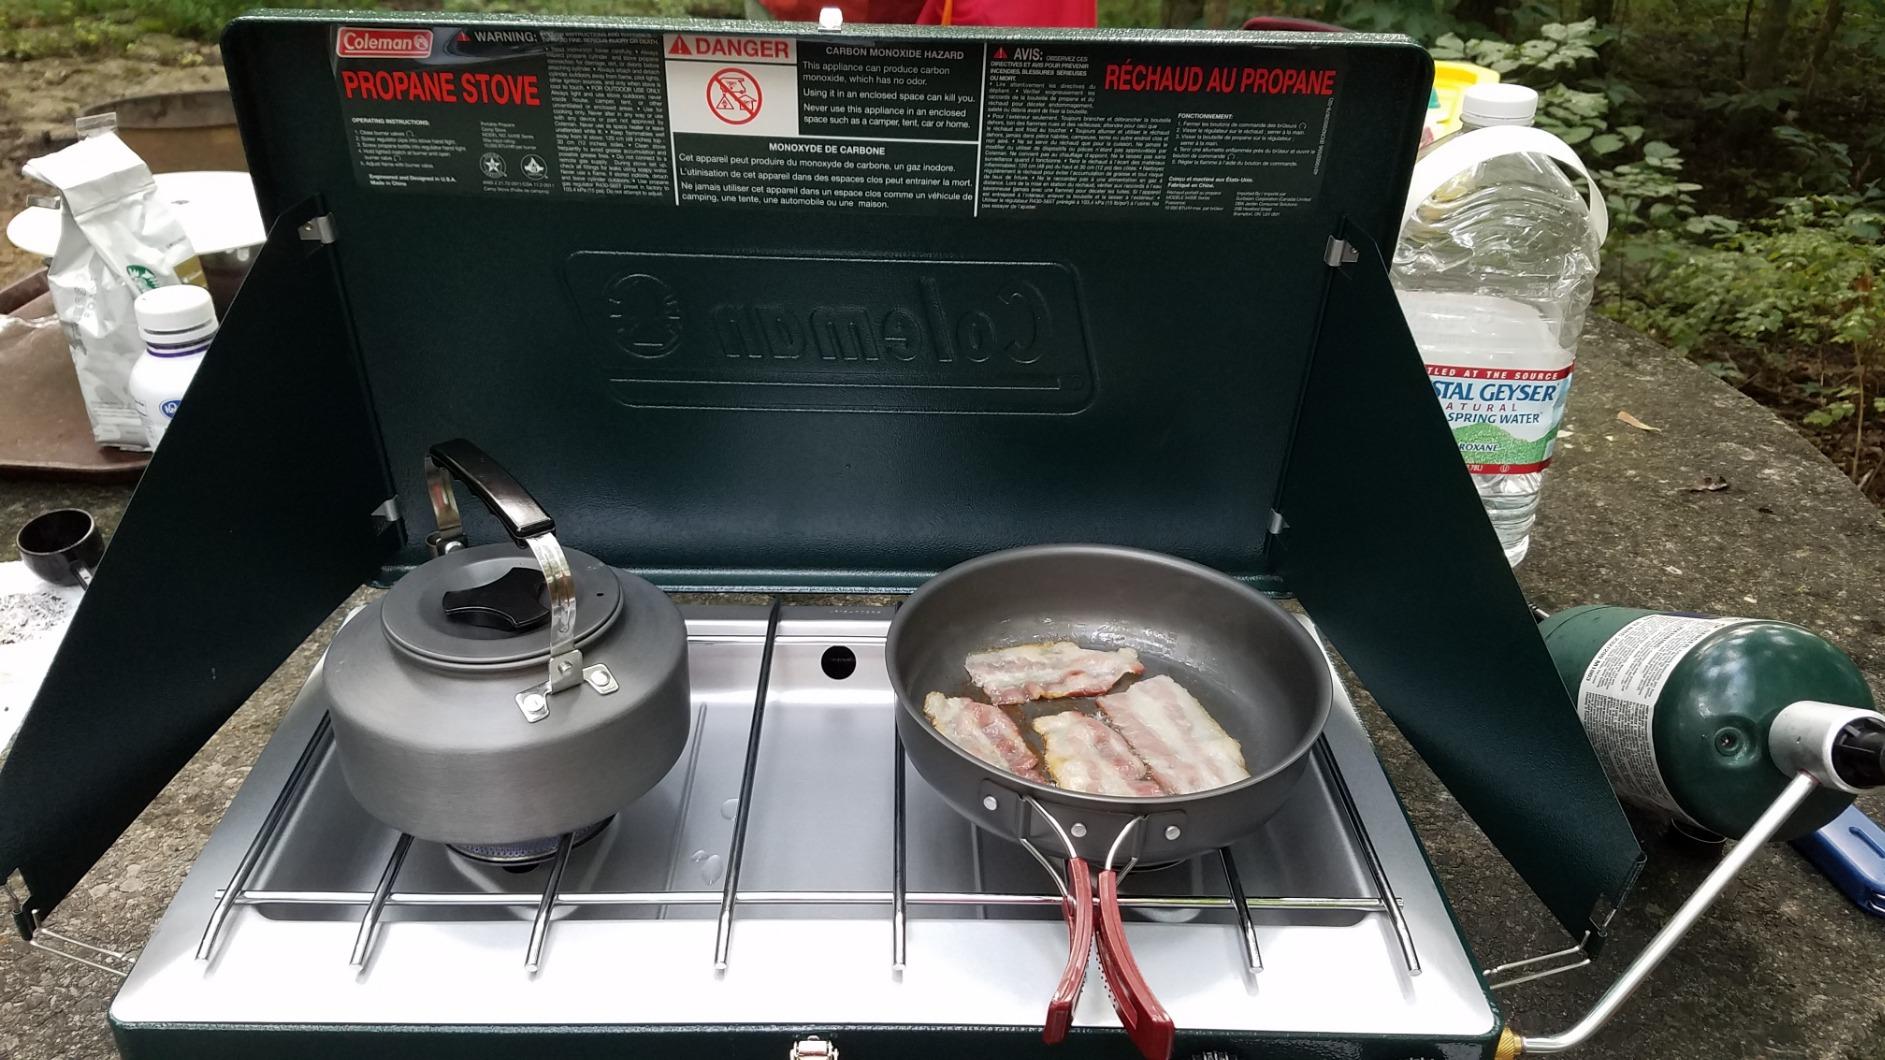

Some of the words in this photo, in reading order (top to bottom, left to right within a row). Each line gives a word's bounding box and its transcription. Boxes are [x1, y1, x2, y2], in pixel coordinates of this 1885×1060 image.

[344, 32, 412, 50] Coleman
[474, 32, 538, 42] WARNING:
[696, 38, 789, 58] DANGER
[826, 47, 867, 56] CARBON
[870, 49, 922, 58] MONOXIDE
[924, 51, 964, 59] HAZARD
[1014, 48, 1043, 61] AVIS:
[802, 61, 821, 70] This
[822, 62, 864, 73] appliance
[883, 65, 919, 74] produce
[803, 74, 847, 82] monoxide,
[849, 75, 874, 83] which
[876, 76, 892, 84] has
[906, 77, 928, 85] odor.
[1104, 58, 1202, 92] RÉCHAUD
[1207, 67, 1237, 93] AU
[1240, 68, 1336, 95] PROPANE
[342, 71, 457, 103] PROPANE
[462, 74, 540, 106] STOVE
[803, 88, 828, 99] Using
[837, 90, 845, 98] in
[804, 104, 828, 112] Never
[847, 105, 863, 113] this
[864, 107, 905, 115] appliance
[869, 119, 900, 127] camper,
[769, 143, 823, 152] MONOXYDE
[825, 145, 838, 153] DE
[840, 146, 885, 155] CARBONE
[679, 153, 694, 162] Cet
[696, 155, 729, 164] appareil
[792, 173, 812, 181] dans
[681, 181, 693, 190] Ne
[695, 183, 721, 191] jamais
[682, 194, 719, 202] camping,
[738, 195, 761, 203] tente,
[763, 195, 779, 204] une
[1427, 366, 1456, 376] TLED
[1486, 371, 1506, 379] THE
[1515, 372, 1558, 380] SOURCE
[1432, 381, 1474, 400] STAL
[1480, 384, 1558, 402] GEYSER
[1446, 402, 1518, 412] ATURAL
[1448, 412, 1496, 423] SPRING
[1500, 414, 1540, 424] WATER
